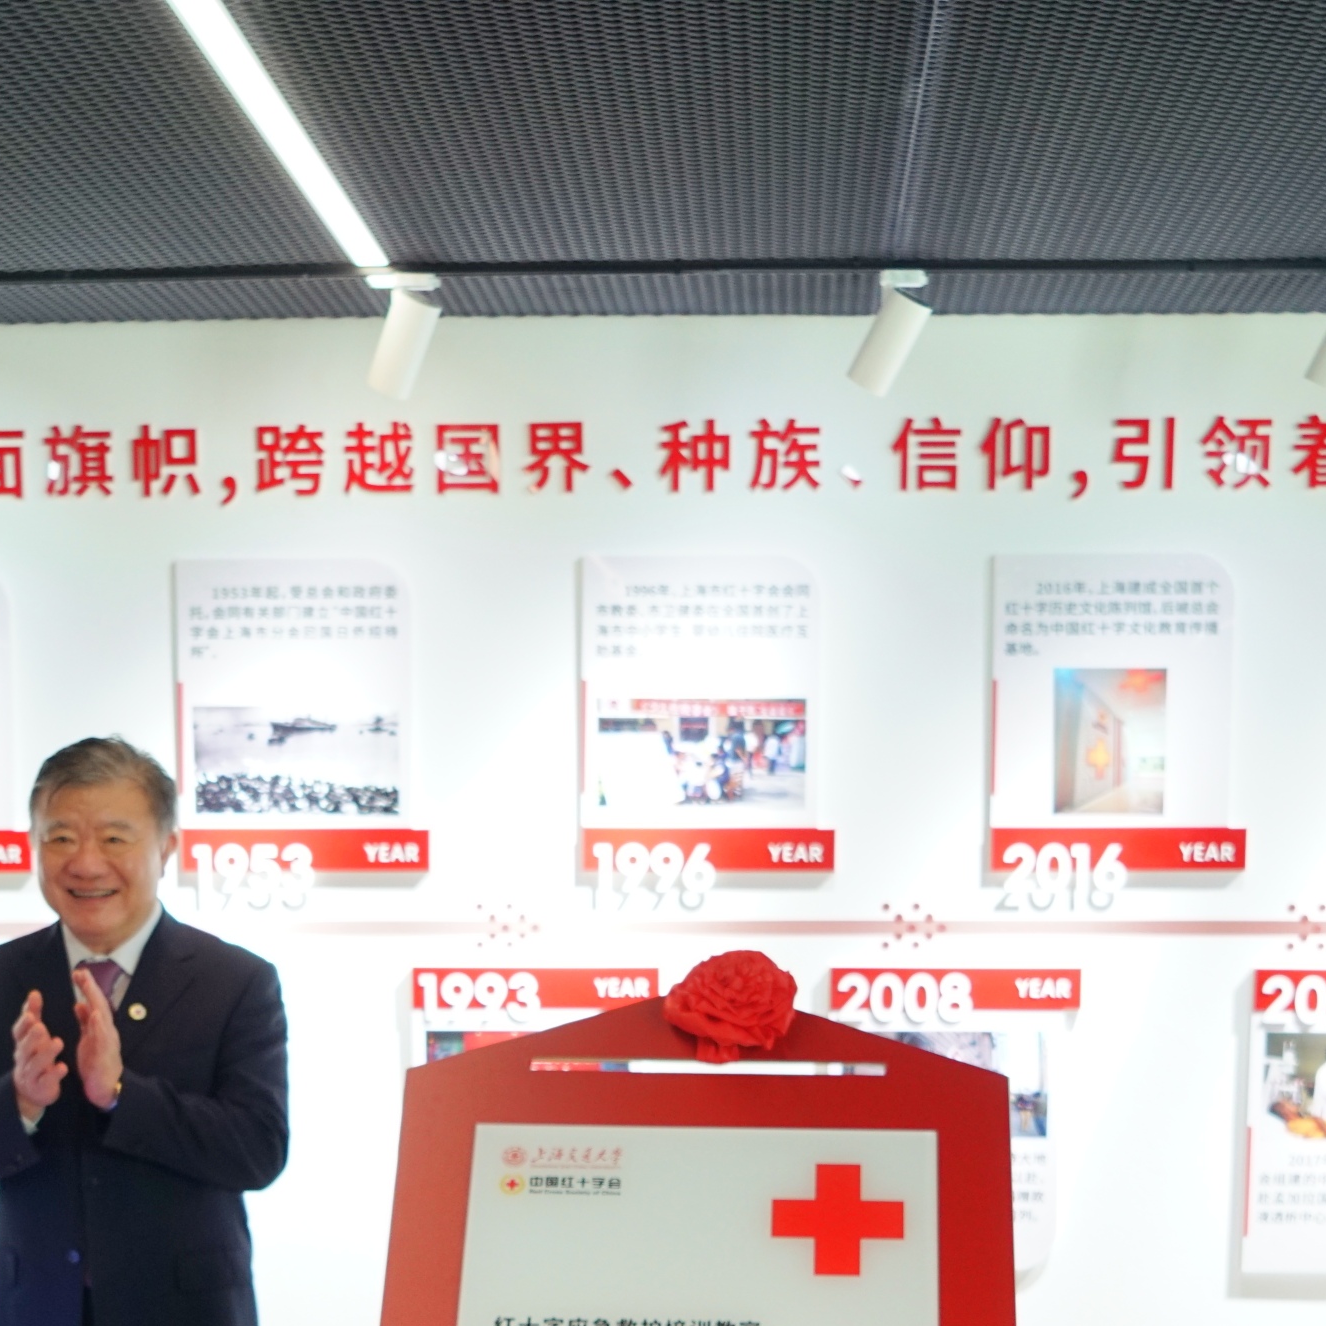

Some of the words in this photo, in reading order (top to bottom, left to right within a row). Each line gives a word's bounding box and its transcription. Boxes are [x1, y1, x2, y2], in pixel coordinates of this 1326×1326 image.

[191, 843, 315, 891] 1953
[362, 843, 420, 863] YEAR
[593, 842, 715, 890] 1996
[767, 842, 824, 863] YEAR
[1003, 842, 1128, 890] 2016
[1177, 842, 1235, 863] YEAR
[418, 972, 541, 1023] 1993
[593, 977, 650, 999] YEAR
[837, 972, 974, 1025] 2008
[1014, 977, 1072, 1000] YEAR
[529, 1175, 621, 1190] 中国红十字会
